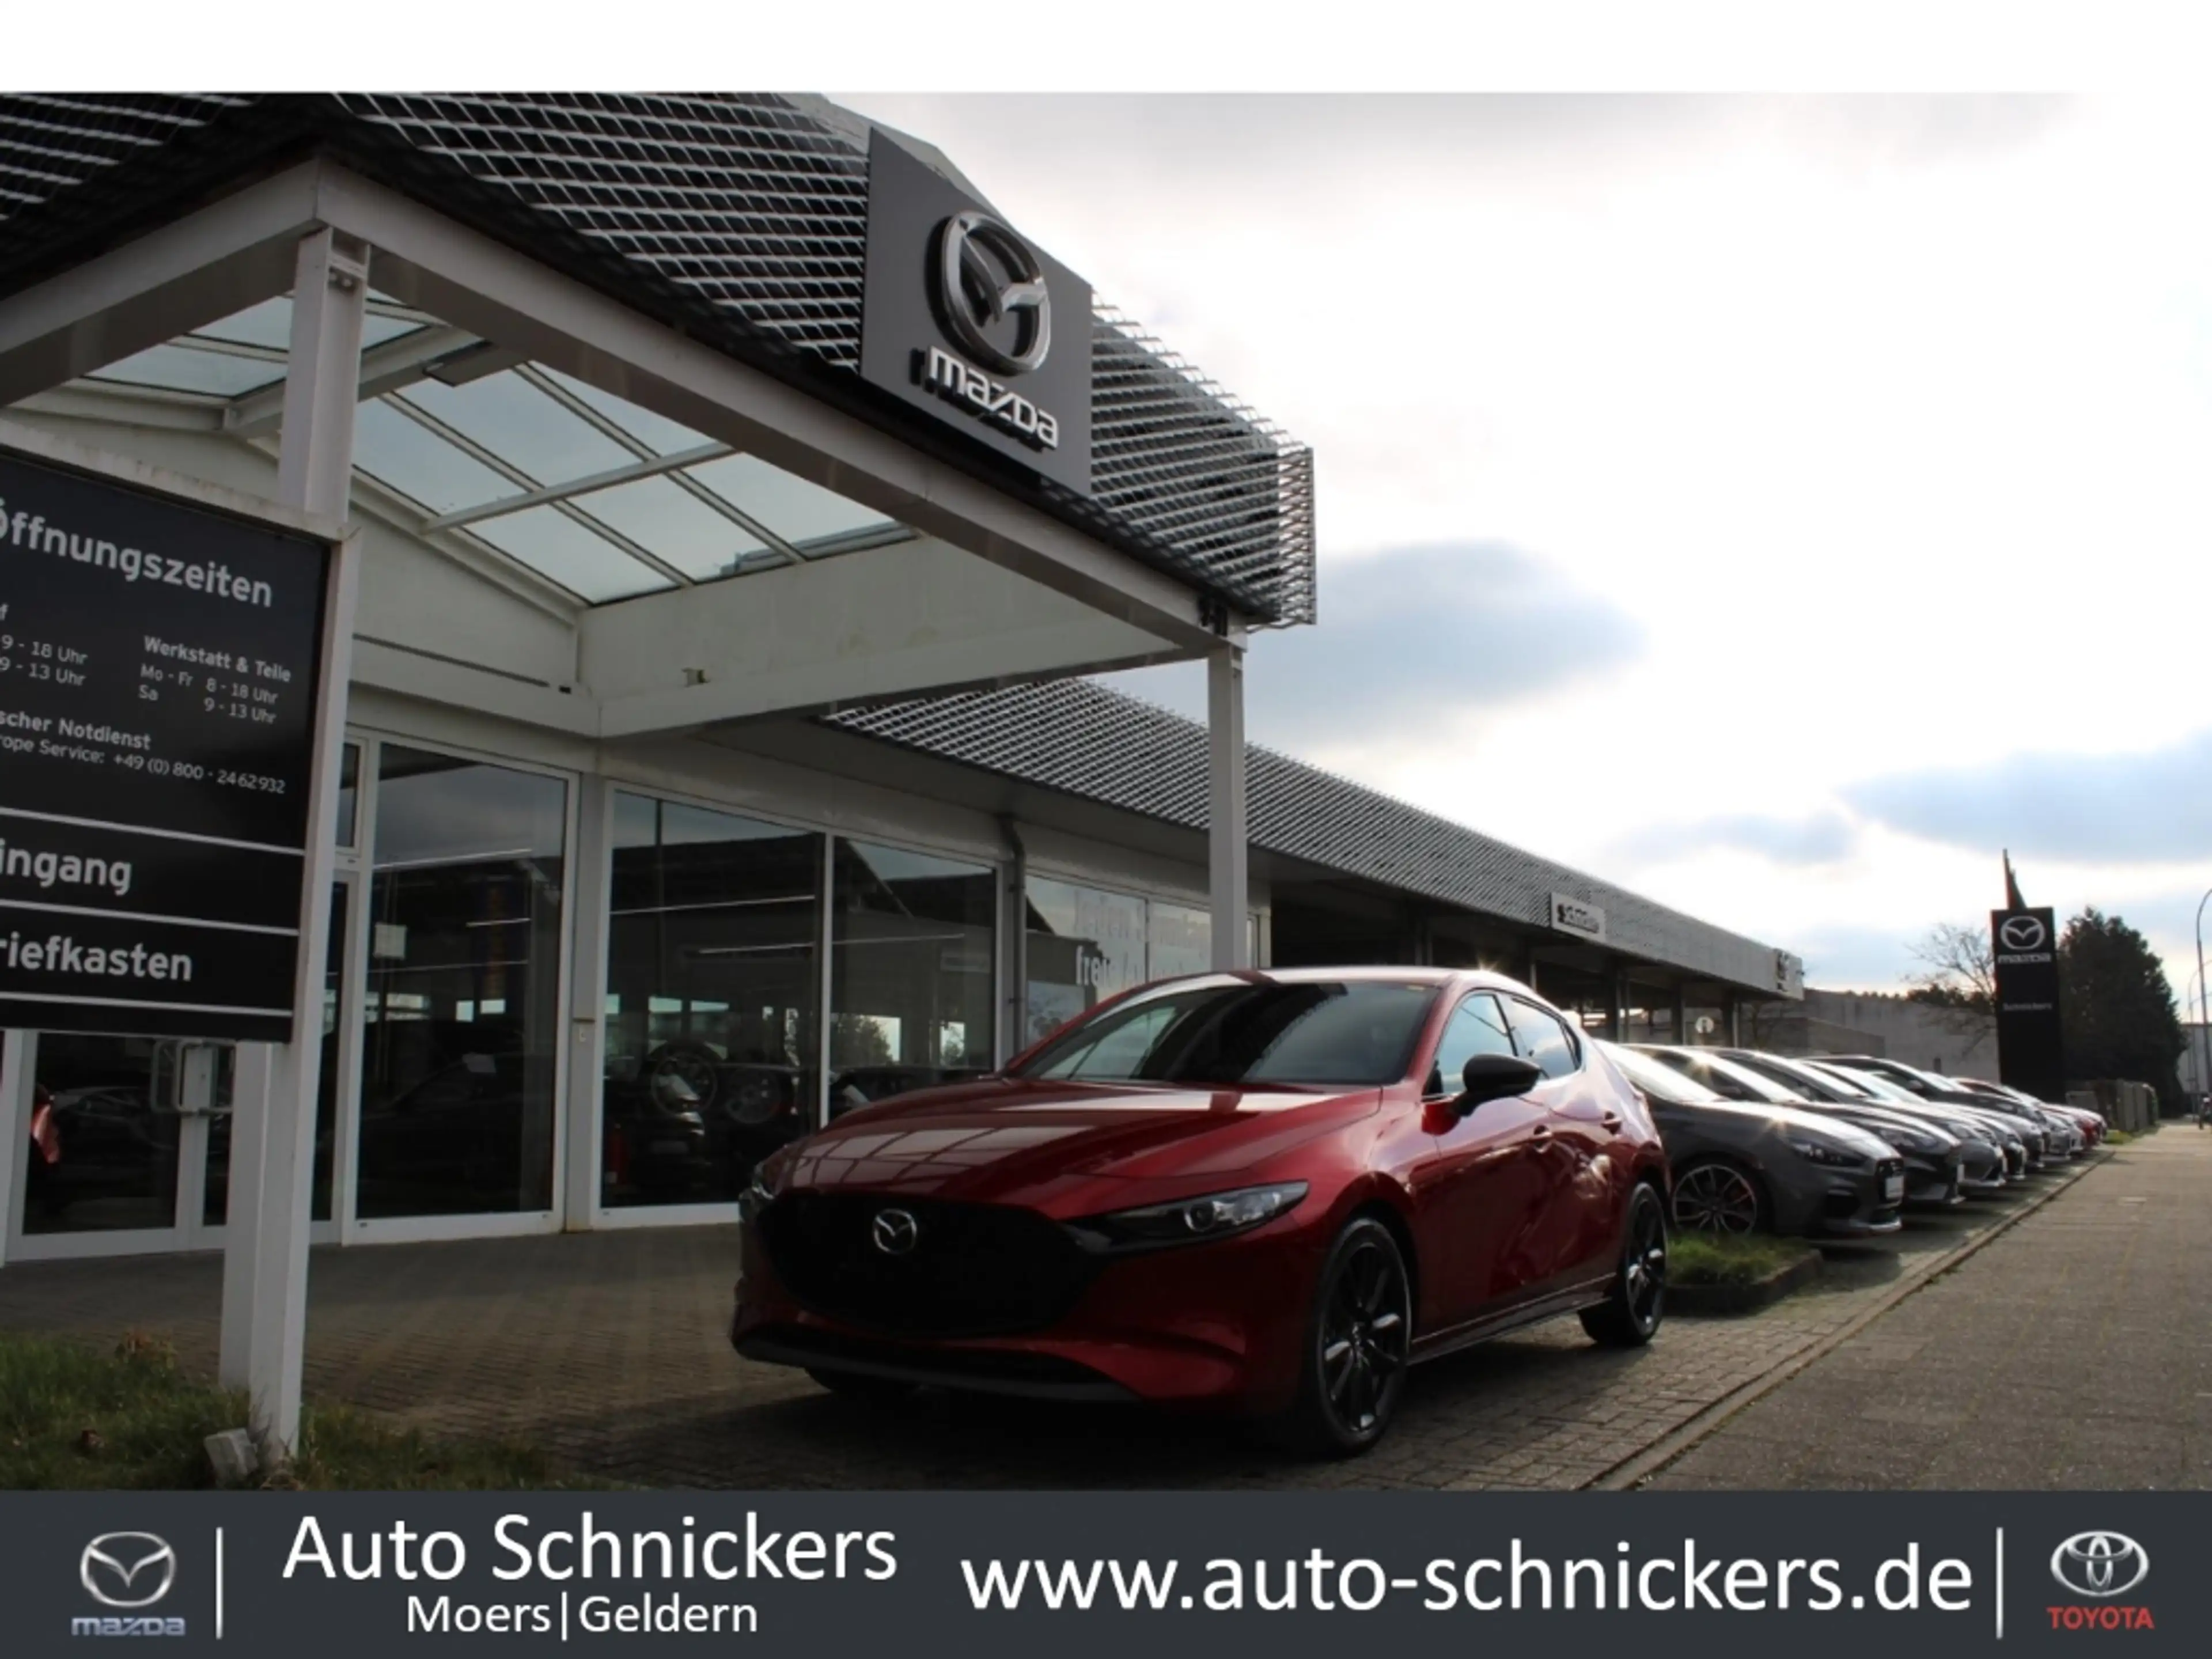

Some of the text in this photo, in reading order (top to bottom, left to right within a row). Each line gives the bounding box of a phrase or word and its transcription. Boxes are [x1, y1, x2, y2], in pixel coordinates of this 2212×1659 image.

[2, 635, 14, 649] 9
[32, 641, 52, 658] 18
[58, 647, 88, 664] Uhr
[145, 636, 291, 682] Werkstatt & Teile
[0, 656, 10, 671] 9
[29, 663, 50, 680] 13
[56, 668, 86, 685] Uhr
[141, 664, 163, 681] Mo
[178, 671, 193, 686] Fr
[206, 677, 217, 692] 8
[232, 683, 249, 699] 18
[253, 687, 278, 703] Uhr
[139, 684, 158, 701] Sa
[204, 698, 215, 711] 9
[229, 703, 247, 718] 13
[251, 707, 276, 724] Uhr
[58, 718, 151, 750] Notdienst
[39, 740, 104, 763] Service:
[115, 755, 145, 770] +49
[147, 757, 170, 775] (0)
[172, 762, 203, 779] 800
[217, 770, 285, 794] 2462932
